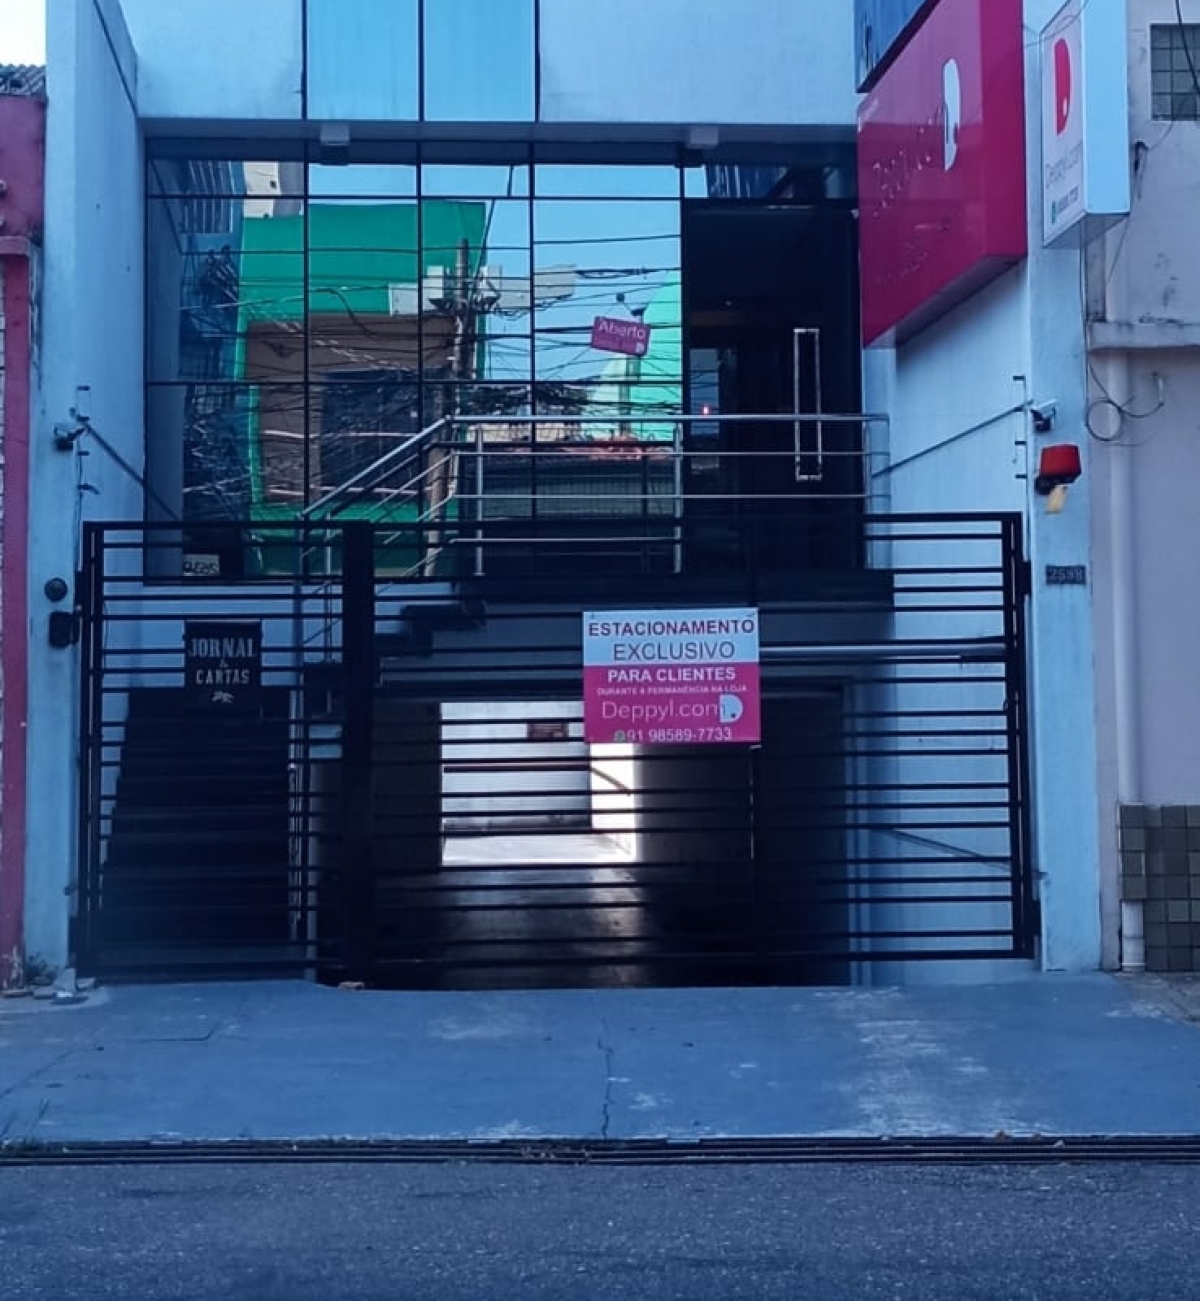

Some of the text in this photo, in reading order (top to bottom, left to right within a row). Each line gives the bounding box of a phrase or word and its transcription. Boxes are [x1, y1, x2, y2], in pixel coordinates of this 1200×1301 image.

[598, 320, 647, 340] Aberto
[588, 619, 755, 637] ESTACIONAMENTO
[190, 637, 257, 658] JORNAL
[613, 641, 736, 661] EXCLUSIVO
[196, 669, 250, 685] CARTAS
[607, 667, 736, 683] PARA CLIENTES
[597, 687, 637, 696] DURANTE
[724, 684, 747, 692] LOJA
[627, 727, 732, 742] 91 98589-7733
